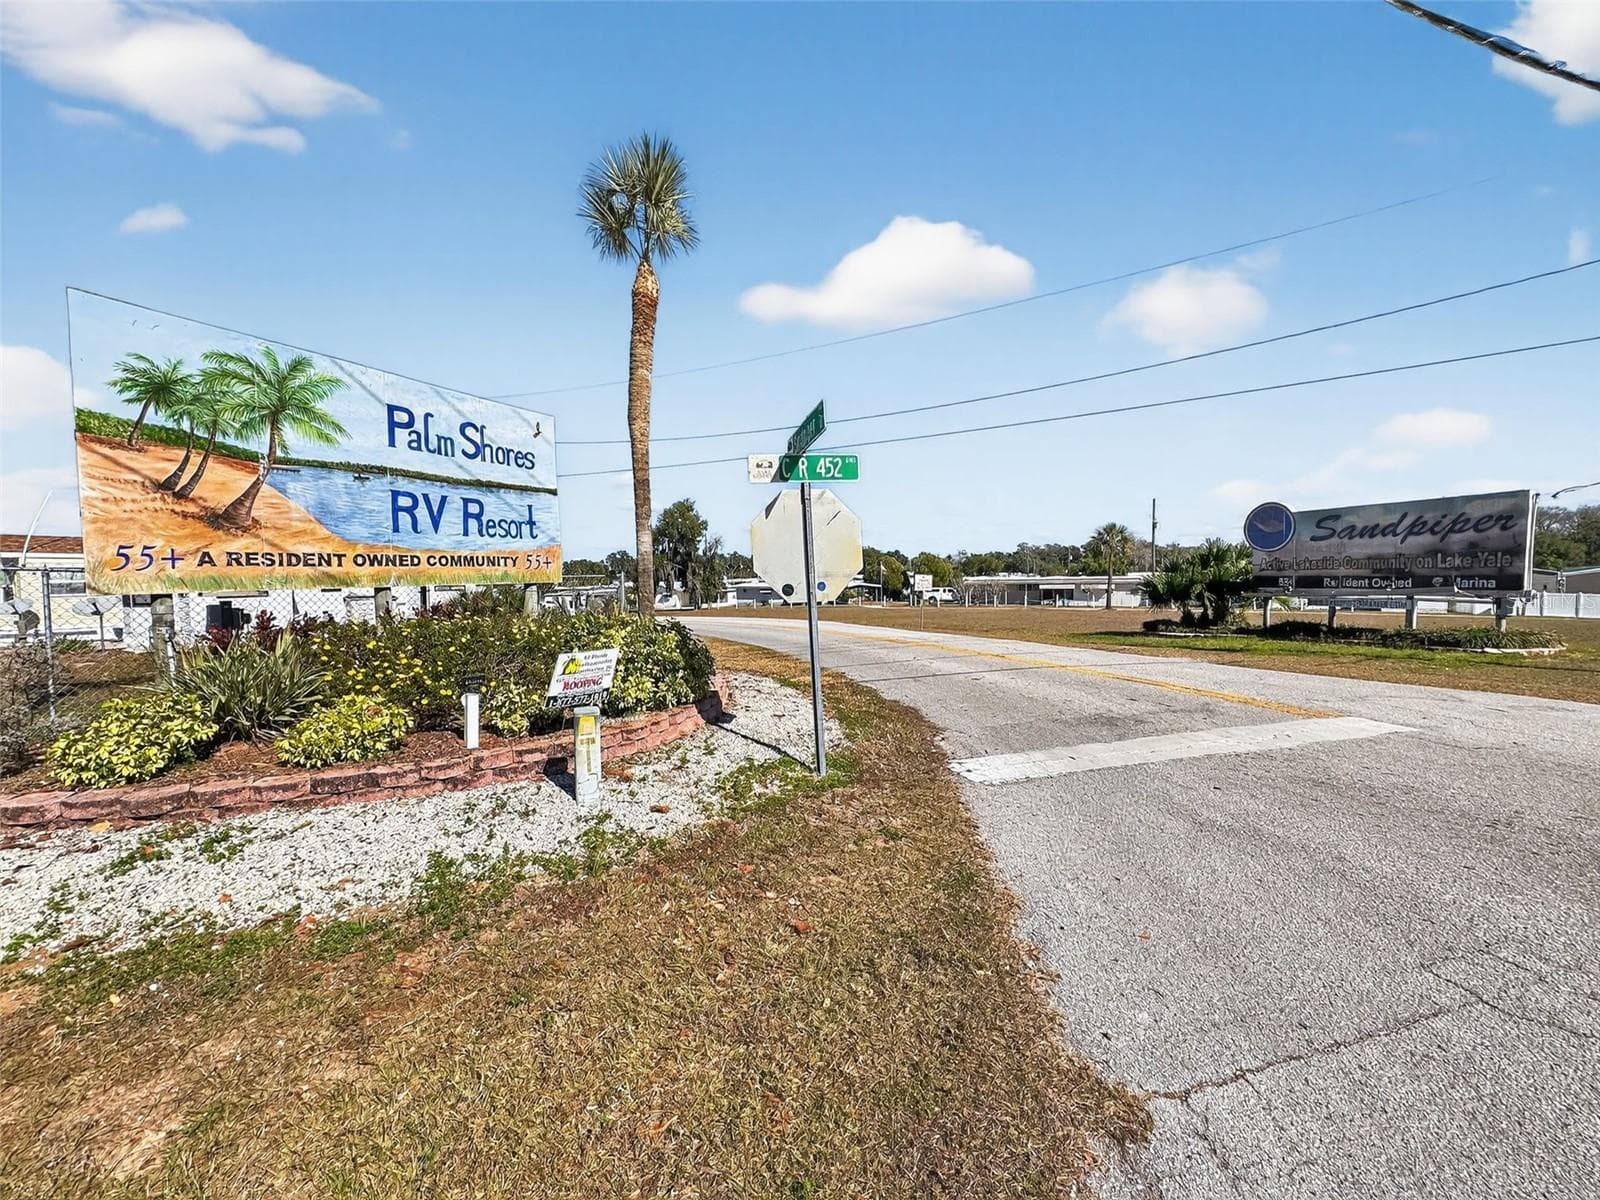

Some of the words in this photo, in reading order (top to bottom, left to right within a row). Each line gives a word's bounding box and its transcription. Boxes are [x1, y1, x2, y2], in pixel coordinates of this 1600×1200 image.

[386, 403, 455, 458] Palm
[459, 421, 535, 470] Shores
[816, 457, 843, 478] 452
[390, 489, 449, 535] RV
[460, 496, 538, 539] Resort
[1310, 511, 1518, 545] Sandpiper
[110, 544, 184, 571] 55+
[197, 551, 217, 567] A
[226, 551, 346, 567] RESIDENT
[352, 553, 421, 568] OWNED
[426, 554, 519, 568] COMMUNITY
[525, 553, 553, 570] 55+
[1343, 555, 1413, 572] Community
[1415, 557, 1433, 569] on
[1437, 552, 1473, 569] Lake
[1477, 551, 1513, 568] Yale
